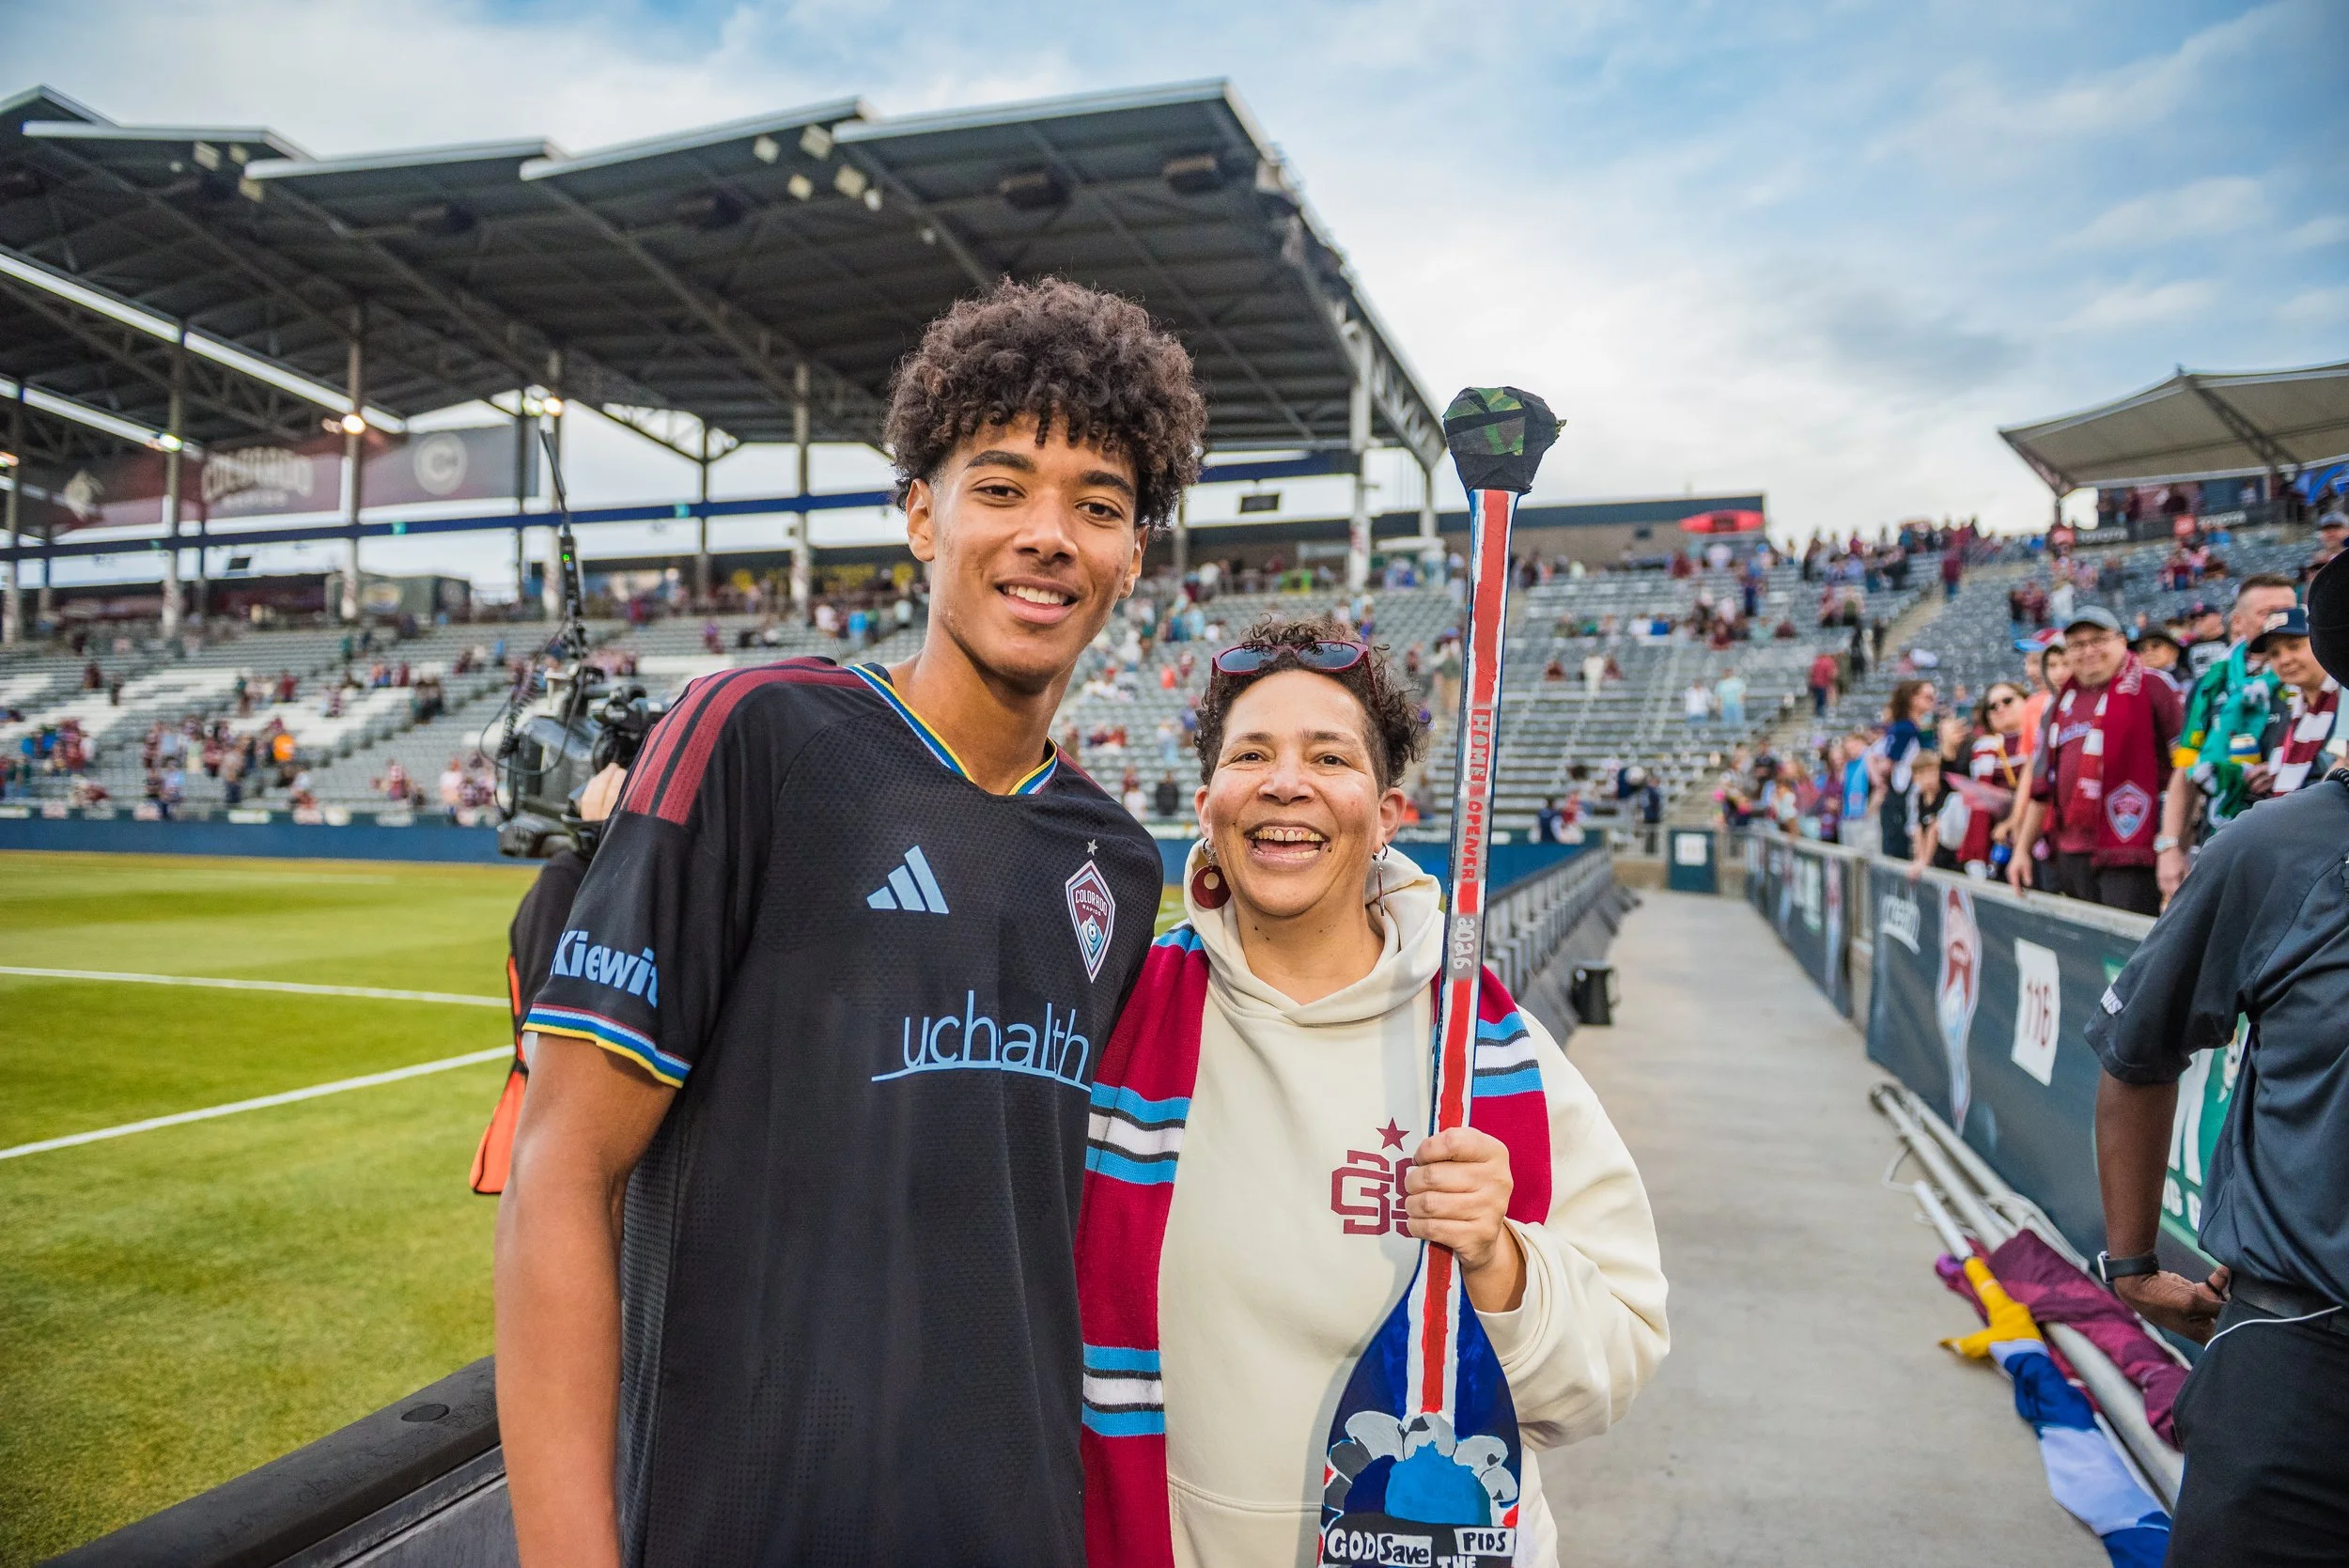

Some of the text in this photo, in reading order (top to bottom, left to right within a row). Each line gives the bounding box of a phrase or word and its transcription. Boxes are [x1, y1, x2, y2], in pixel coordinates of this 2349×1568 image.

[1453, 711, 1489, 970] HOME OPENER 2026
[1075, 890, 1108, 917] COLORADO
[1081, 904, 1101, 917] RAPIDS
[902, 989, 1090, 1082] uchalth
[1327, 1528, 1430, 1564] GOD Save
[1463, 1531, 1506, 1552] PIDS
